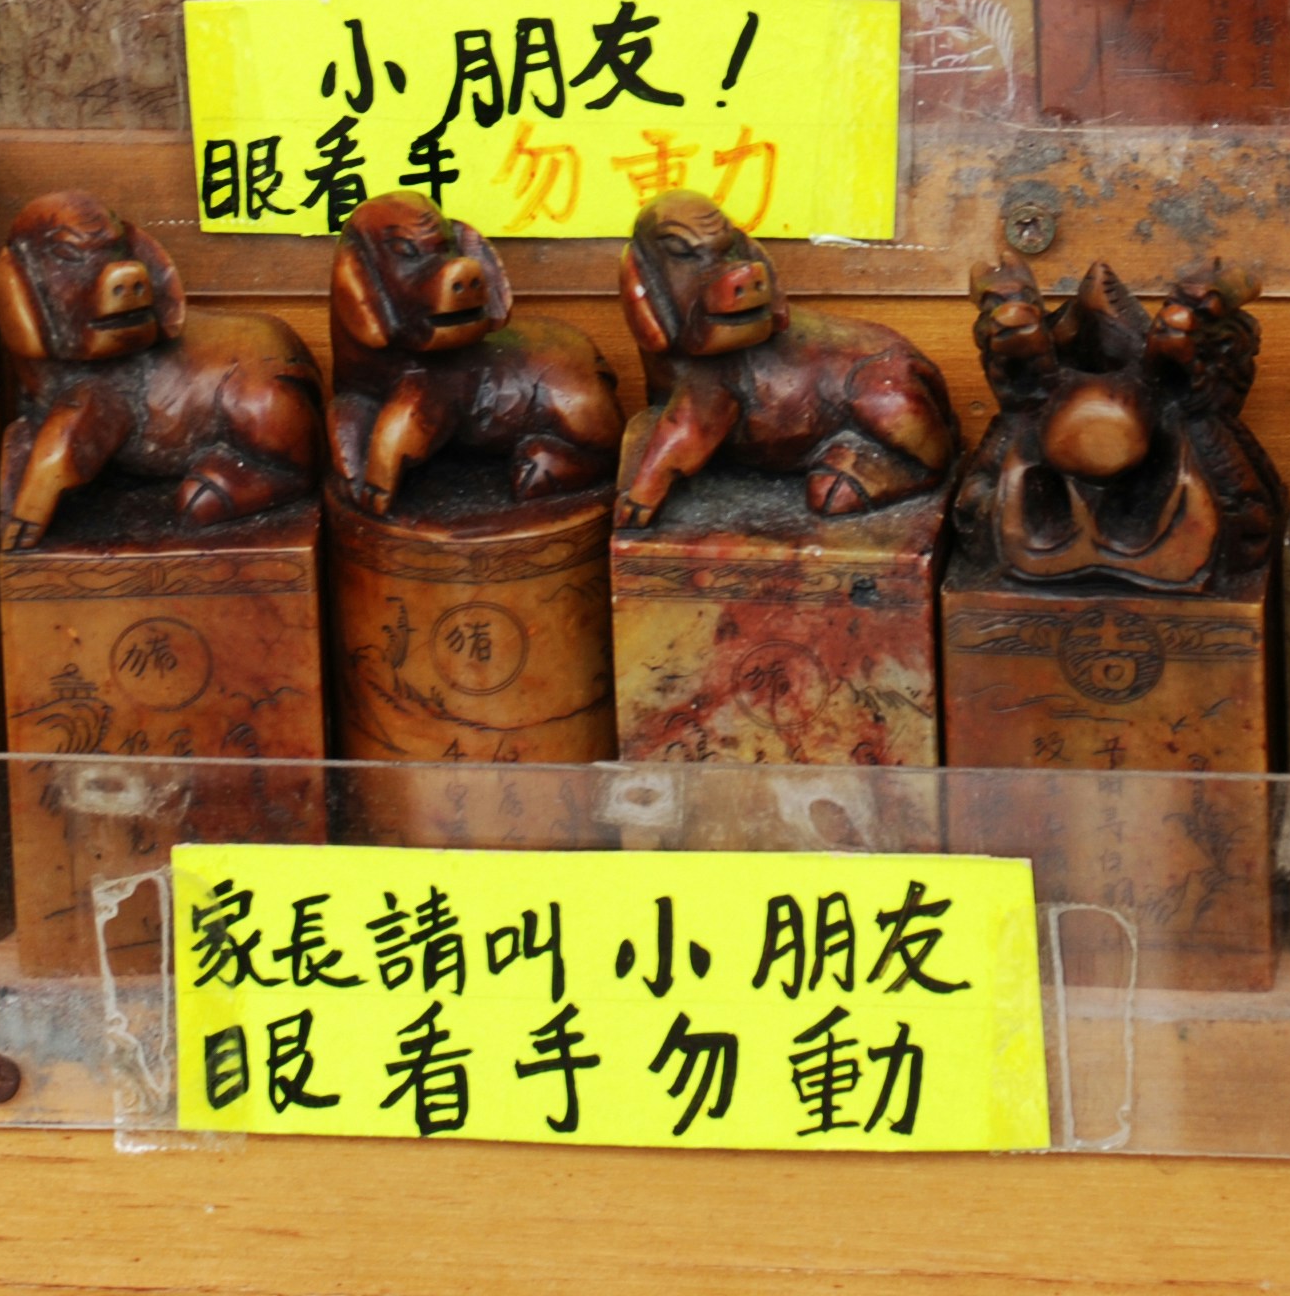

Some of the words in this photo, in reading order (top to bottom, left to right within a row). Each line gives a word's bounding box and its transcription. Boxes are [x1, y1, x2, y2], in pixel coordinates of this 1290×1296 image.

[200, 112, 778, 234] 眼看手勿動
[191, 879, 971, 1003] 家長請叫小朋友
[204, 1000, 924, 1138] 眼看手勿動
